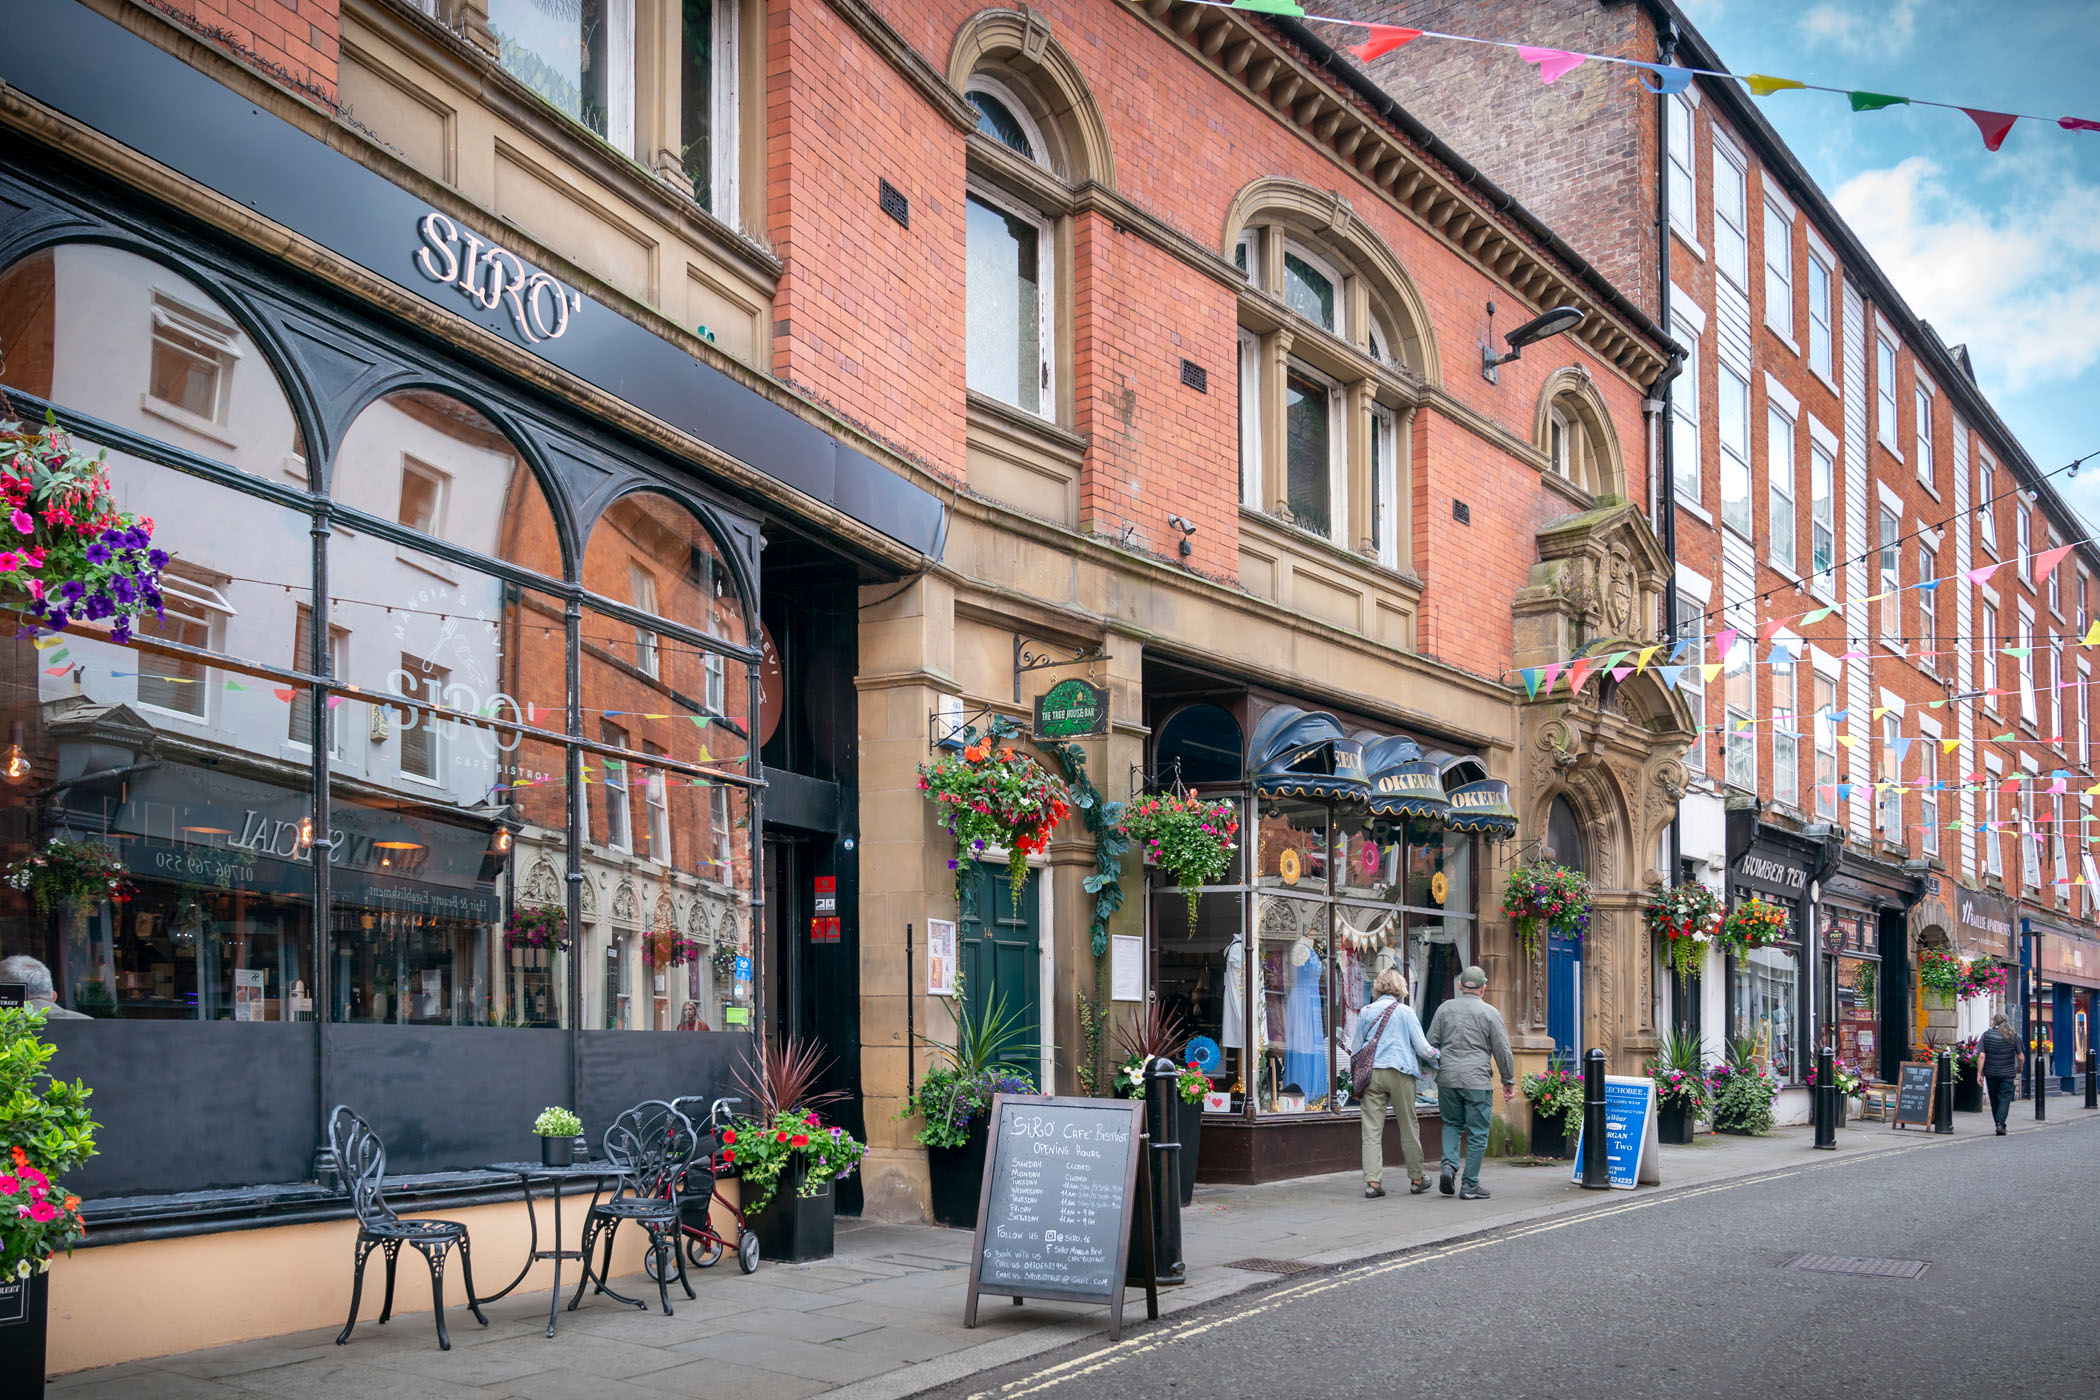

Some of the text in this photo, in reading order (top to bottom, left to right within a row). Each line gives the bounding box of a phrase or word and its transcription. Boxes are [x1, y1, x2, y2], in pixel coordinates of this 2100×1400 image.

[393, 587, 504, 657] MANGIA & BEVI
[1041, 708, 1095, 721] THE TREE HOUSE BAR
[496, 763, 550, 781] BISTROT
[1742, 855, 1806, 888] NUMBER TEN
[984, 927, 992, 940] 14
[1012, 1157, 1091, 1172] SUNDAY CLOSED
[1009, 1177, 1038, 1186] TUESDAY
[1011, 1169, 1087, 1182] MONDAY CLOSED
[1010, 1186, 1043, 1196] WEDNESDAY
[997, 1224, 1023, 1239] FOLLOW
